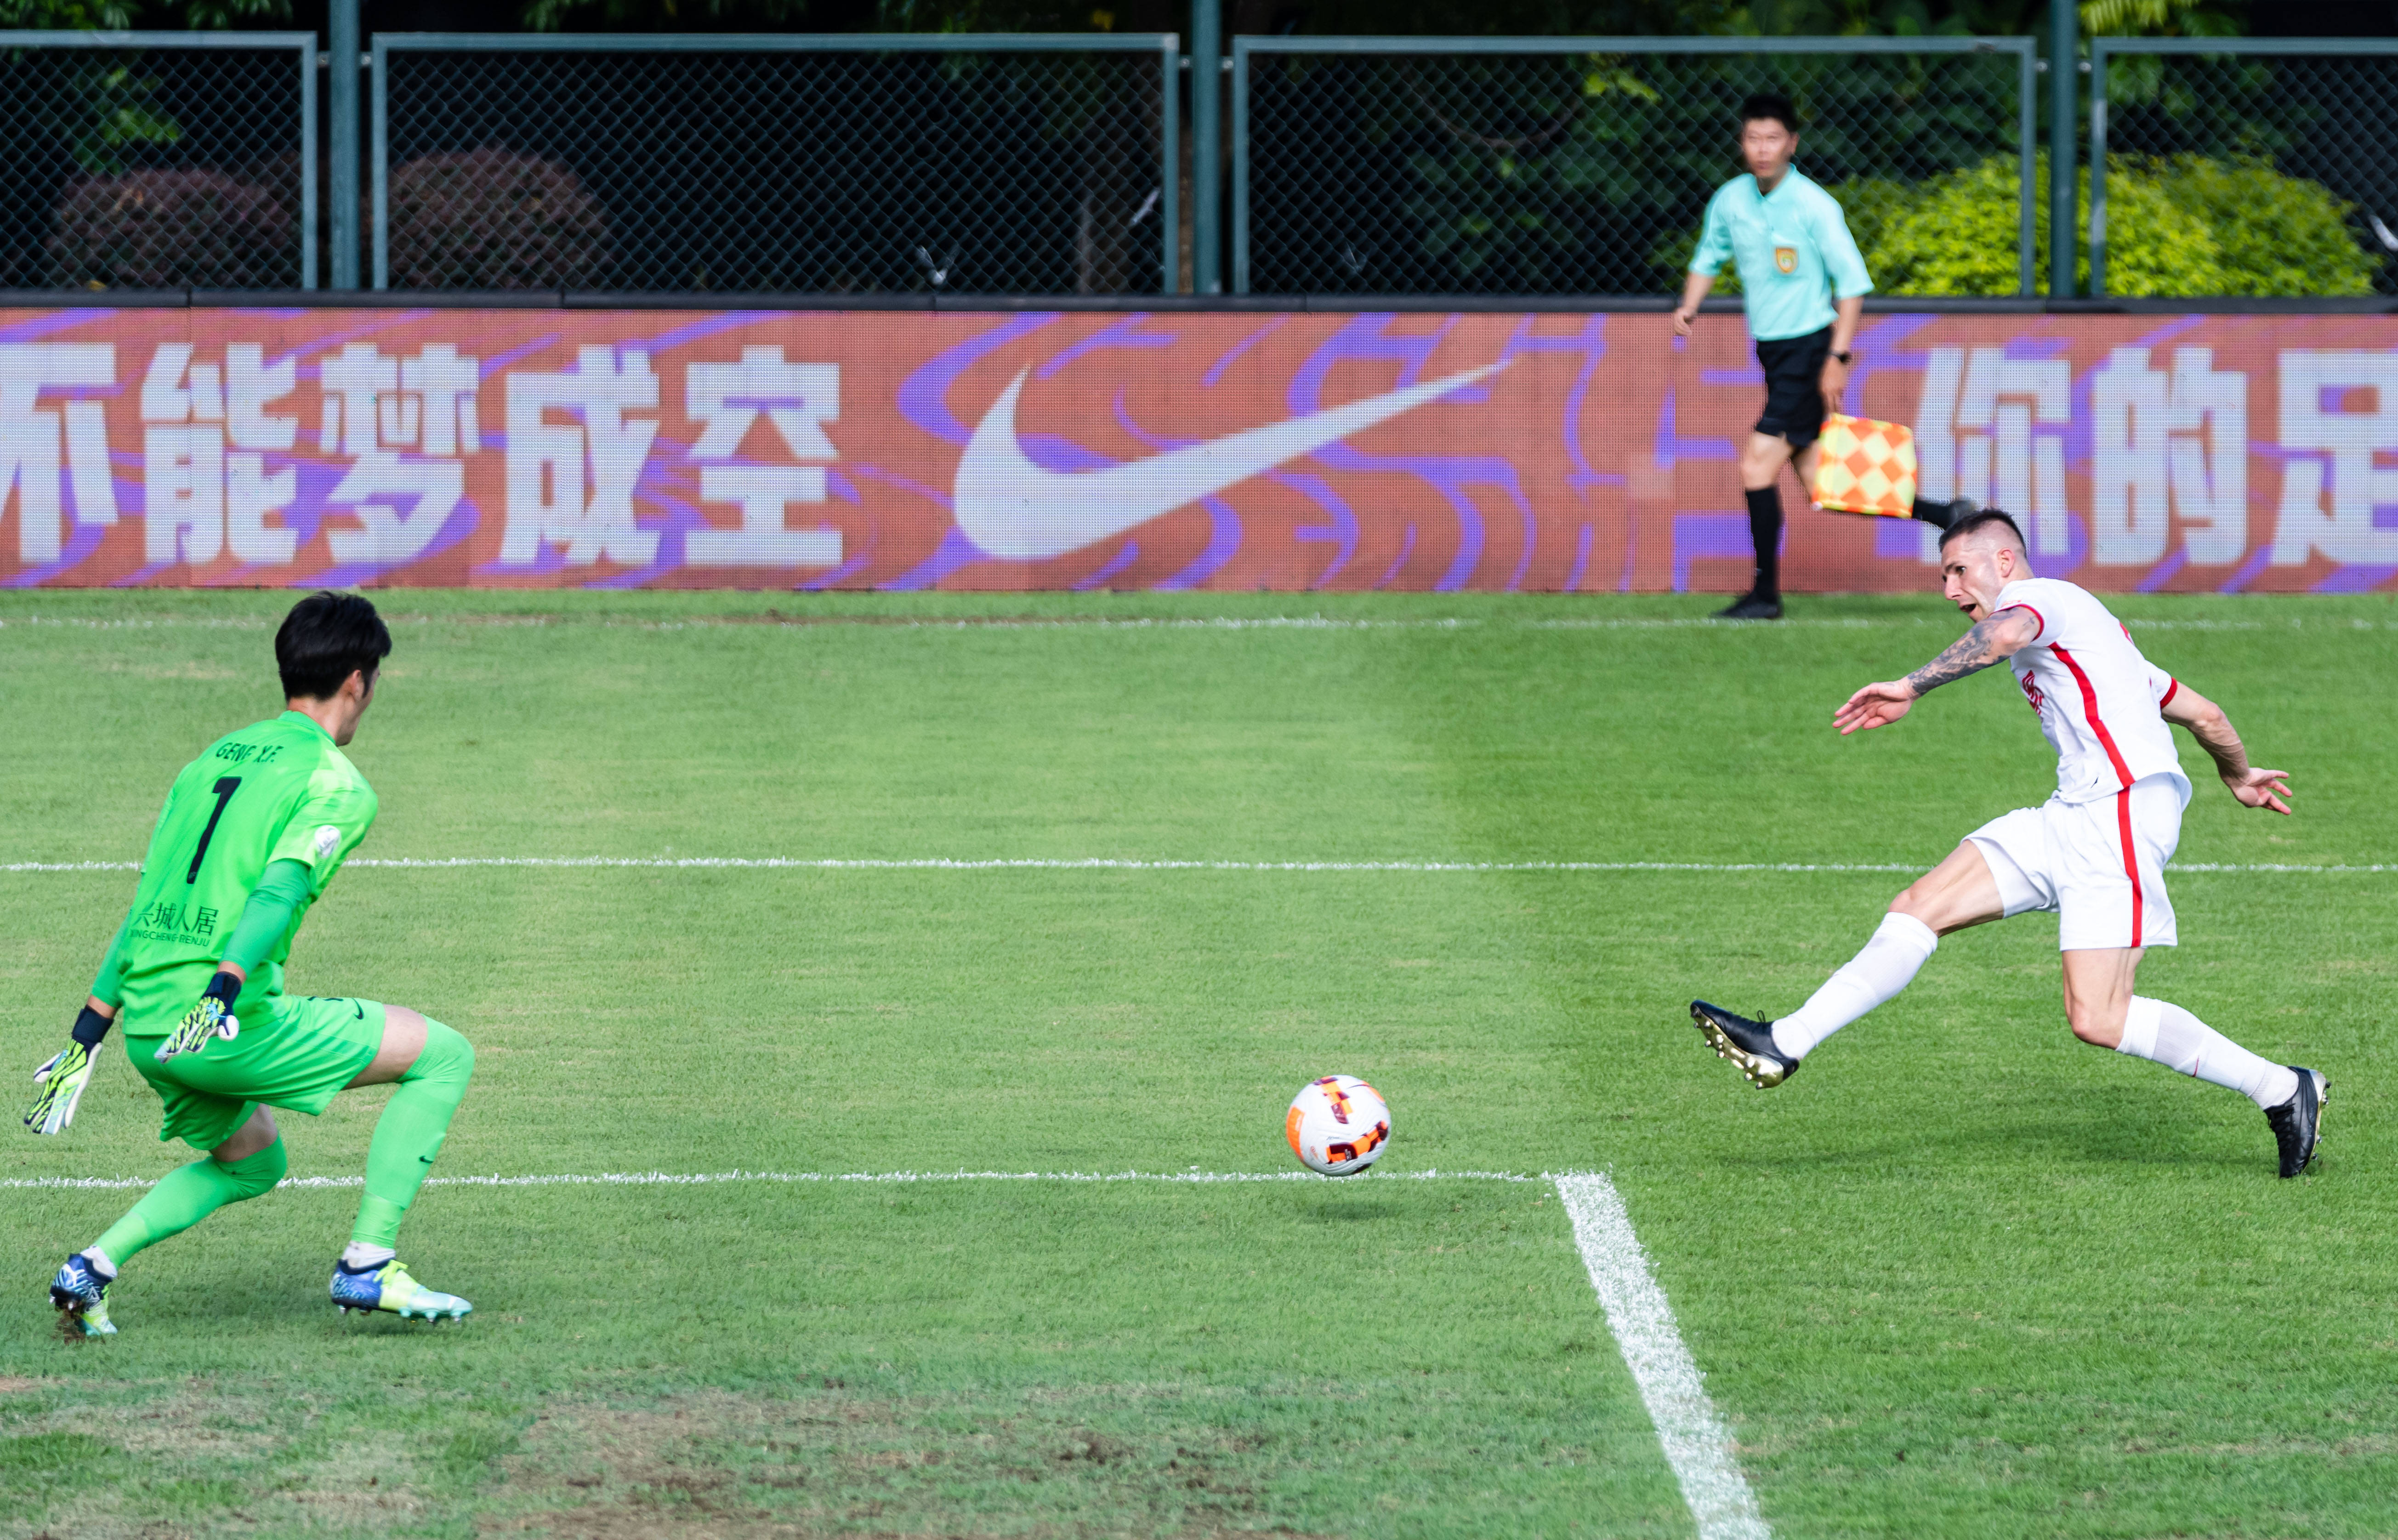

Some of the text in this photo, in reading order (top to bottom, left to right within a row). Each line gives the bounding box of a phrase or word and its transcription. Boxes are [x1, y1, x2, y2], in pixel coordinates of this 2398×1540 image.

[0, 342, 842, 567] 不能梦成空
[1916, 347, 2398, 566] 你的足
[187, 776, 242, 884] 1
